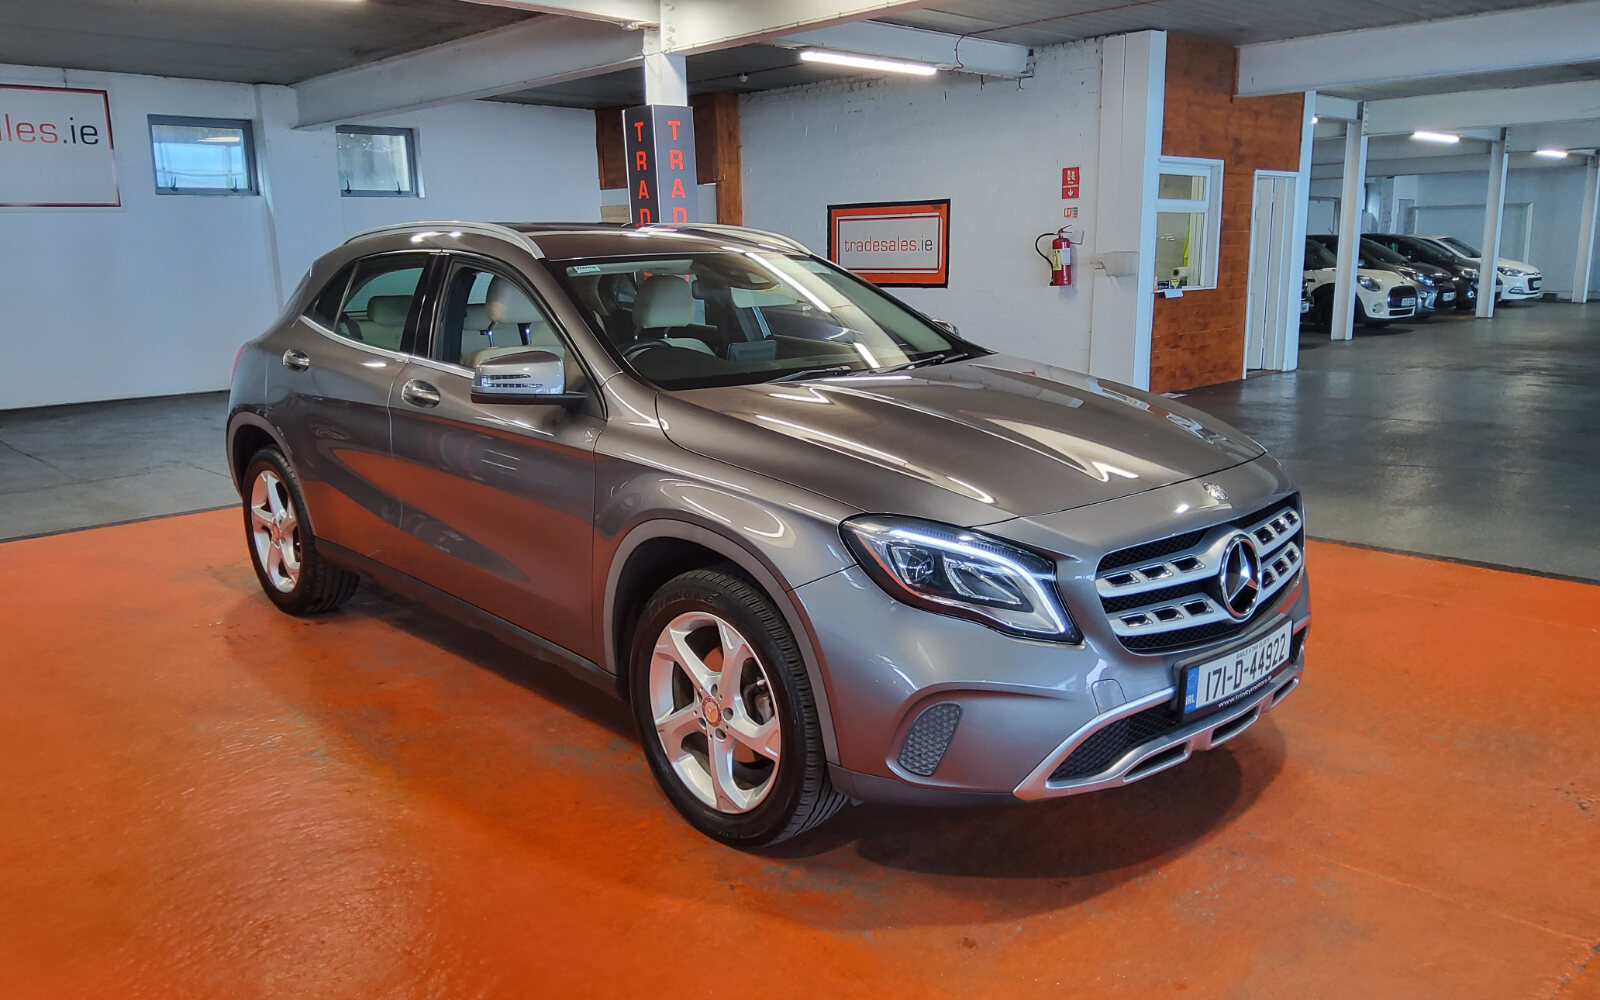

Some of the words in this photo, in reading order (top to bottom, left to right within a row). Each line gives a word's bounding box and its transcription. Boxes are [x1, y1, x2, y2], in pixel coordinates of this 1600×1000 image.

[0, 113, 99, 145] les.ie
[844, 234, 933, 253] tradesales.ie
[1206, 633, 1286, 702] 171-D-44922
[1185, 693, 1195, 706] IRL
